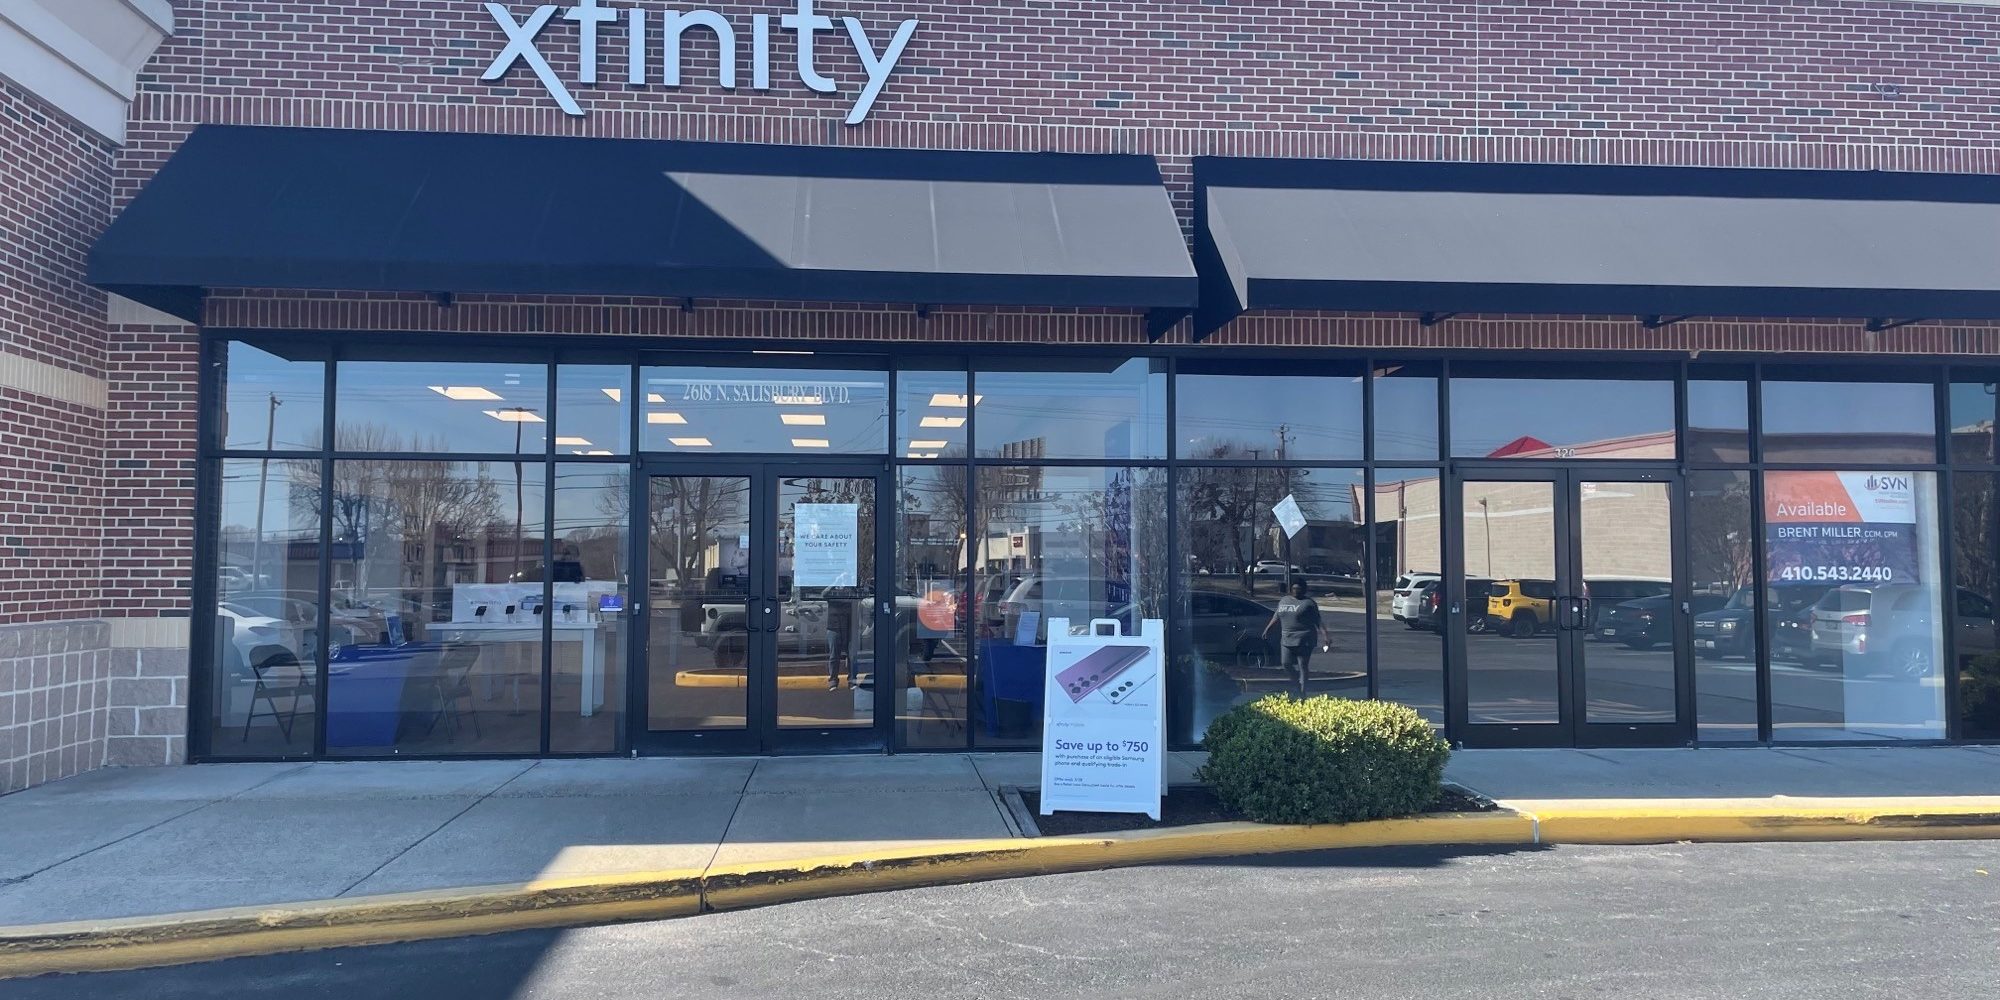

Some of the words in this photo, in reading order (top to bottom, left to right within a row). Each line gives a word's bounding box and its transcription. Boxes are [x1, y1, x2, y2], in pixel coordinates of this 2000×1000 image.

[480, 0, 919, 125] xfinity
[683, 383, 711, 401] 2618
[717, 384, 730, 401] N.
[734, 384, 806, 403] SALISBURY
[814, 386, 850, 404] BLVD.
[1555, 448, 1575, 458] 320
[1881, 476, 1908, 490] SVN
[1776, 502, 1847, 517] Available
[1778, 527, 1818, 538] BRENT
[1781, 566, 1892, 581] 410.543.2440
[1055, 739, 1084, 750] Save
[1087, 742, 1103, 753] up
[1106, 741, 1119, 751] to
[1122, 740, 1149, 752] $750
